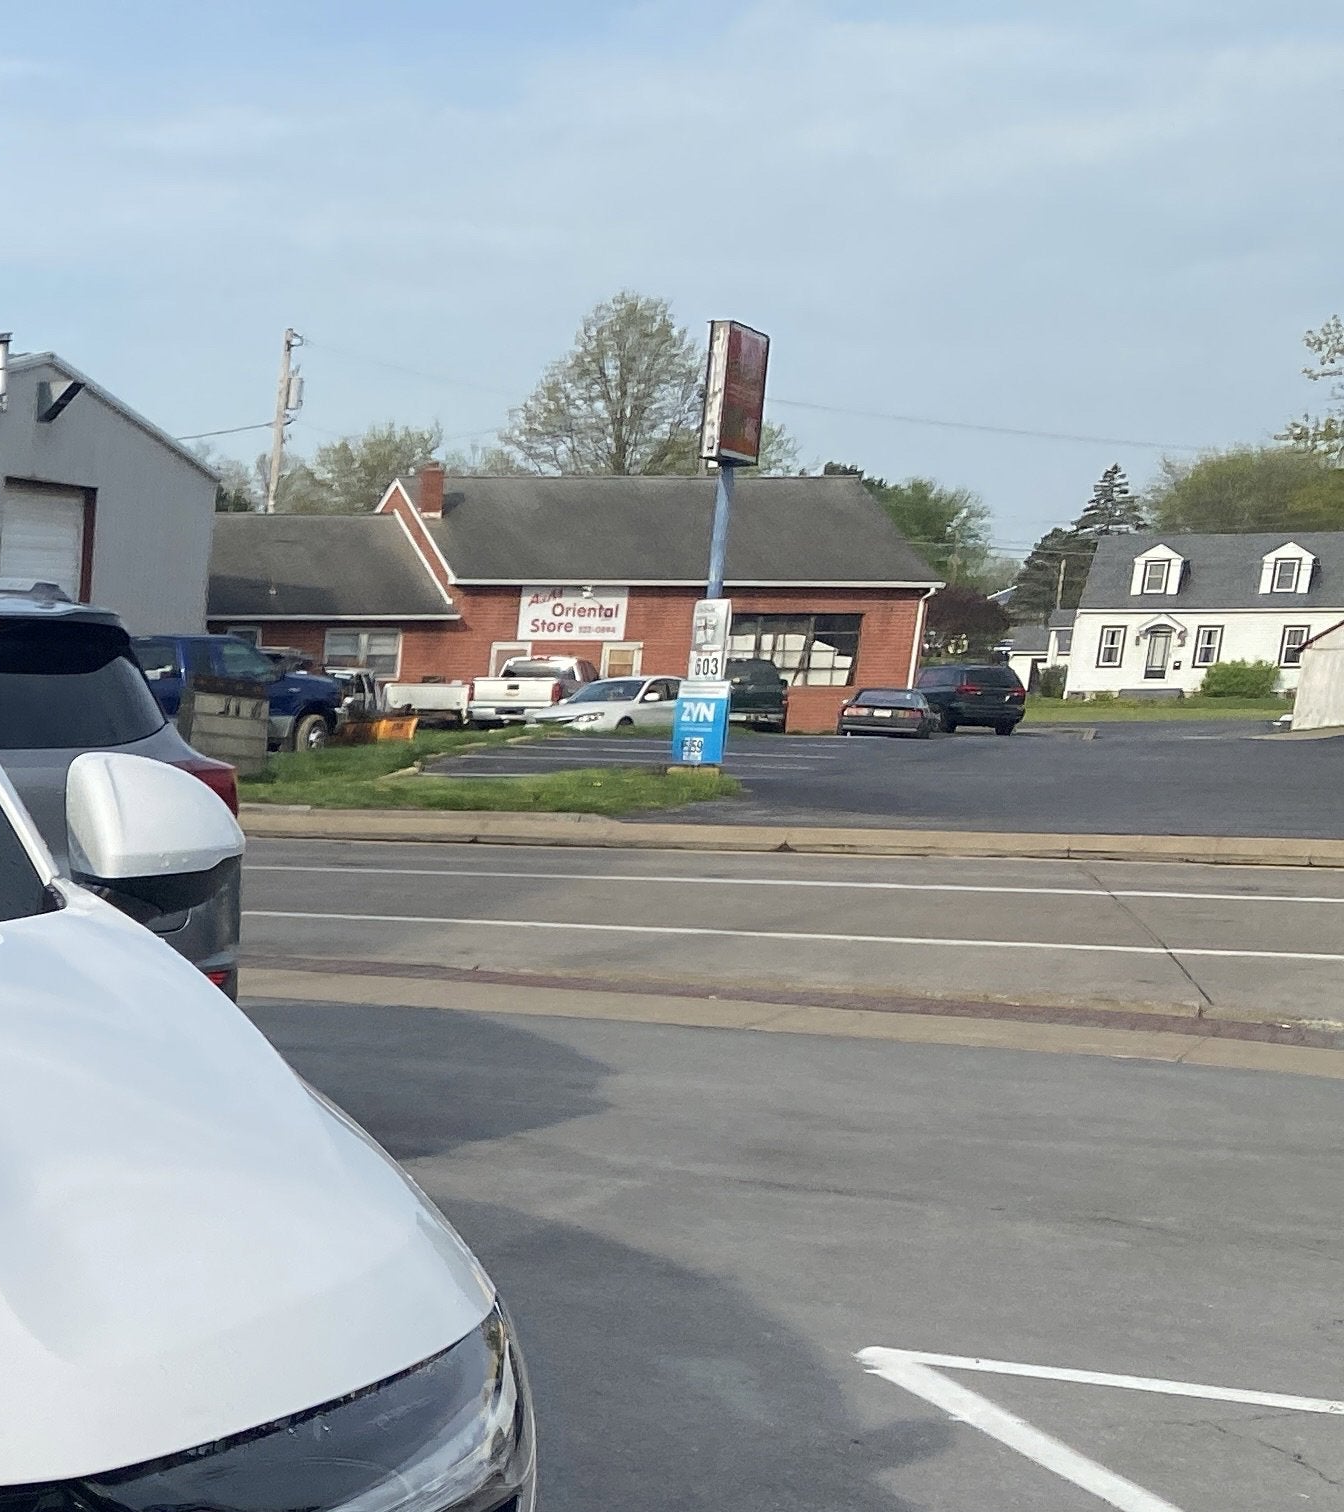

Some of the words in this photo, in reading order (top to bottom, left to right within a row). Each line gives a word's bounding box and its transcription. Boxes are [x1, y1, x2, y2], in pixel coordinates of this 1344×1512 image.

[552, 602, 620, 618] Oriental
[530, 618, 574, 633] Store
[681, 702, 716, 722] ZYN
